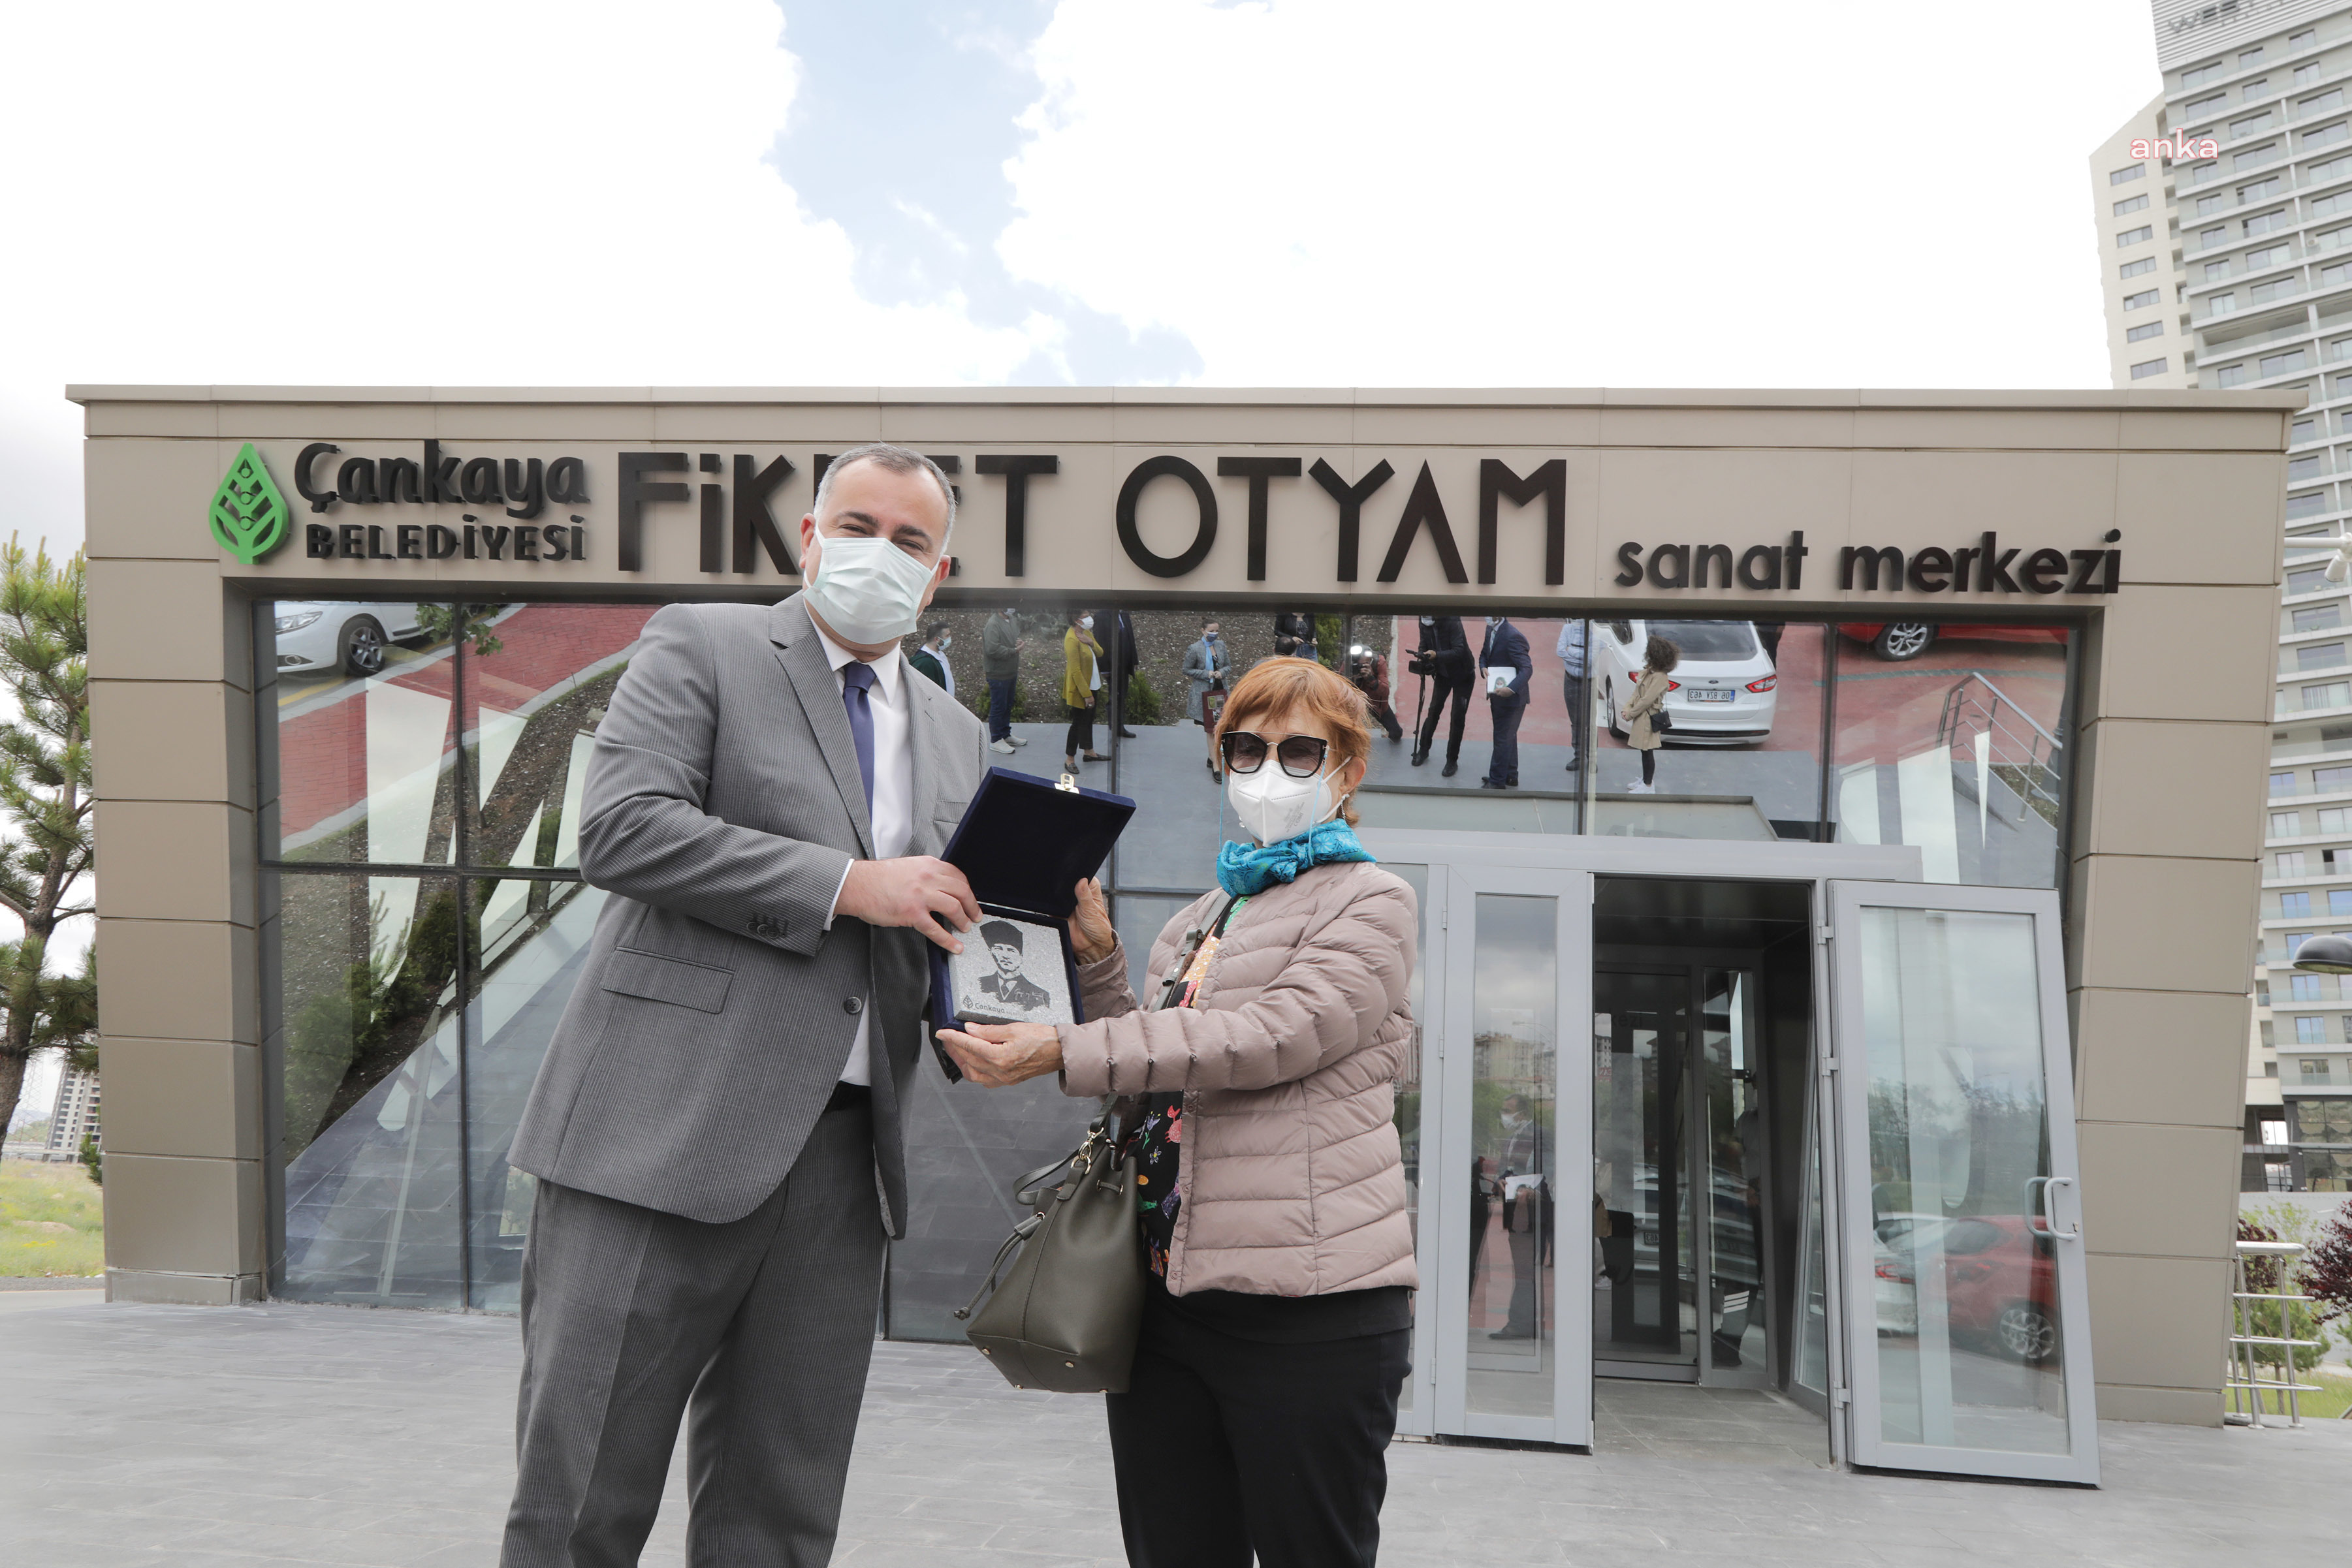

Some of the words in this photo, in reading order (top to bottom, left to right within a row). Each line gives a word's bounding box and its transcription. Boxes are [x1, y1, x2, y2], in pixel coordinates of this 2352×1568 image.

[2168, 0, 2253, 33] WES
[294, 439, 590, 518] Çankaya
[306, 514, 586, 561] BELEDİYESİ
[1116, 455, 1567, 586] OTYAM
[1615, 530, 1809, 590] sanat
[1839, 528, 2122, 594] merkezi
